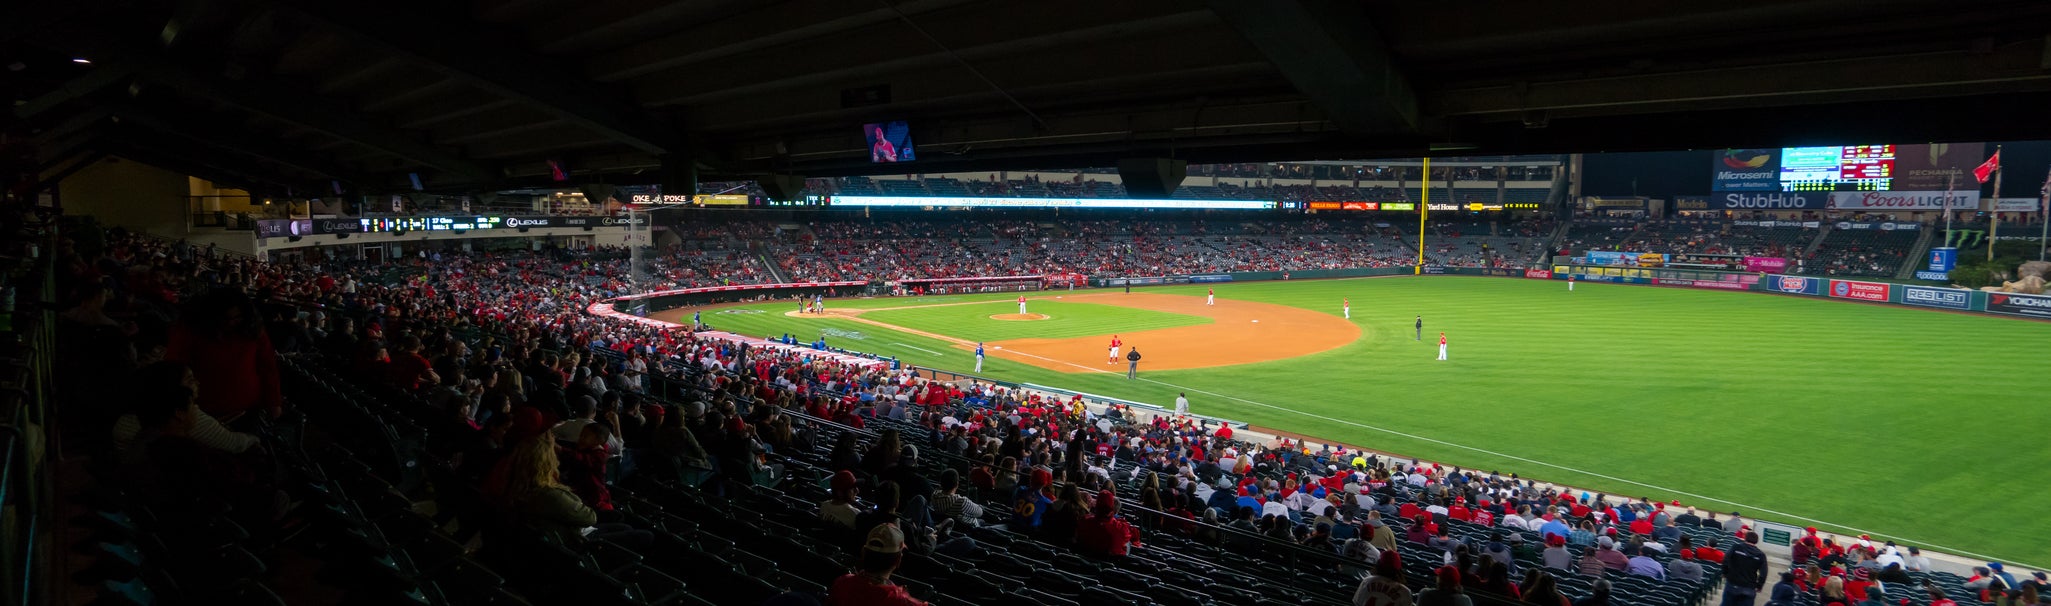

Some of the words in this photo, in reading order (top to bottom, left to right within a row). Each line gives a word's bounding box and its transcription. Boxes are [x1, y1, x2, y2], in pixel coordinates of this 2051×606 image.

[1717, 170, 1774, 180] Microsemi
[1725, 193, 1807, 208] StubHub
[1861, 190, 1917, 207] Coors
[1918, 195, 1969, 207] LIGHT
[1428, 203, 1440, 211] Yard
[1441, 203, 1458, 211] House
[1851, 283, 1883, 292] Insurance
[1851, 291, 1883, 300] AAA.com
[1908, 289, 1933, 300] RES
[1935, 292, 1964, 304] LIST
